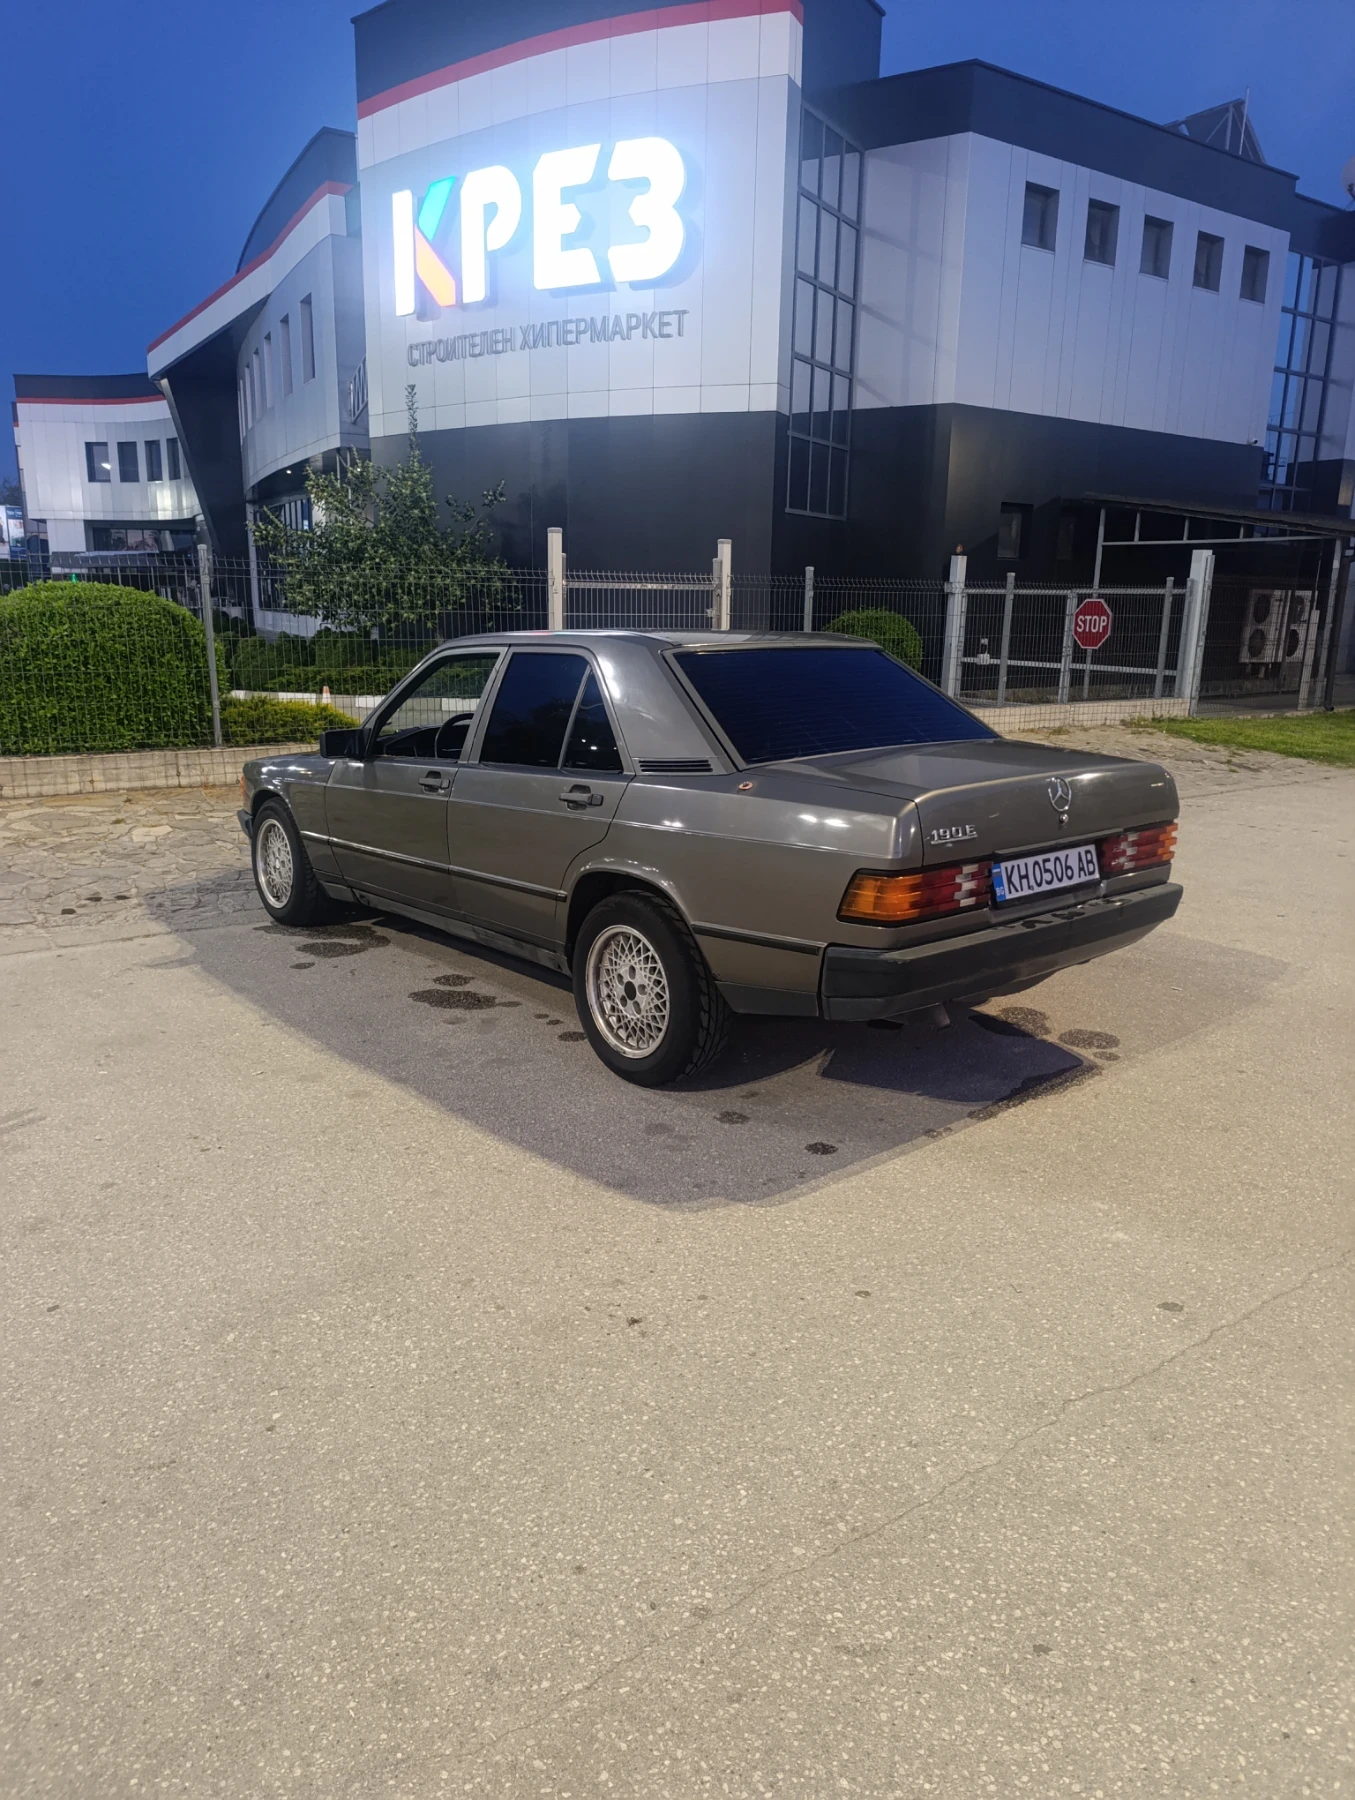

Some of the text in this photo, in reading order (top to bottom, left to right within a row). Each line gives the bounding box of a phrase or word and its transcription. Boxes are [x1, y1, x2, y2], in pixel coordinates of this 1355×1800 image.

[391, 136, 686, 317] КРЕЗ
[407, 309, 689, 367] СТРОИТЕЛЕН ХИПЕРМАРКЕТ
[1076, 615, 1108, 633] STOP
[930, 826, 963, 842] 190
